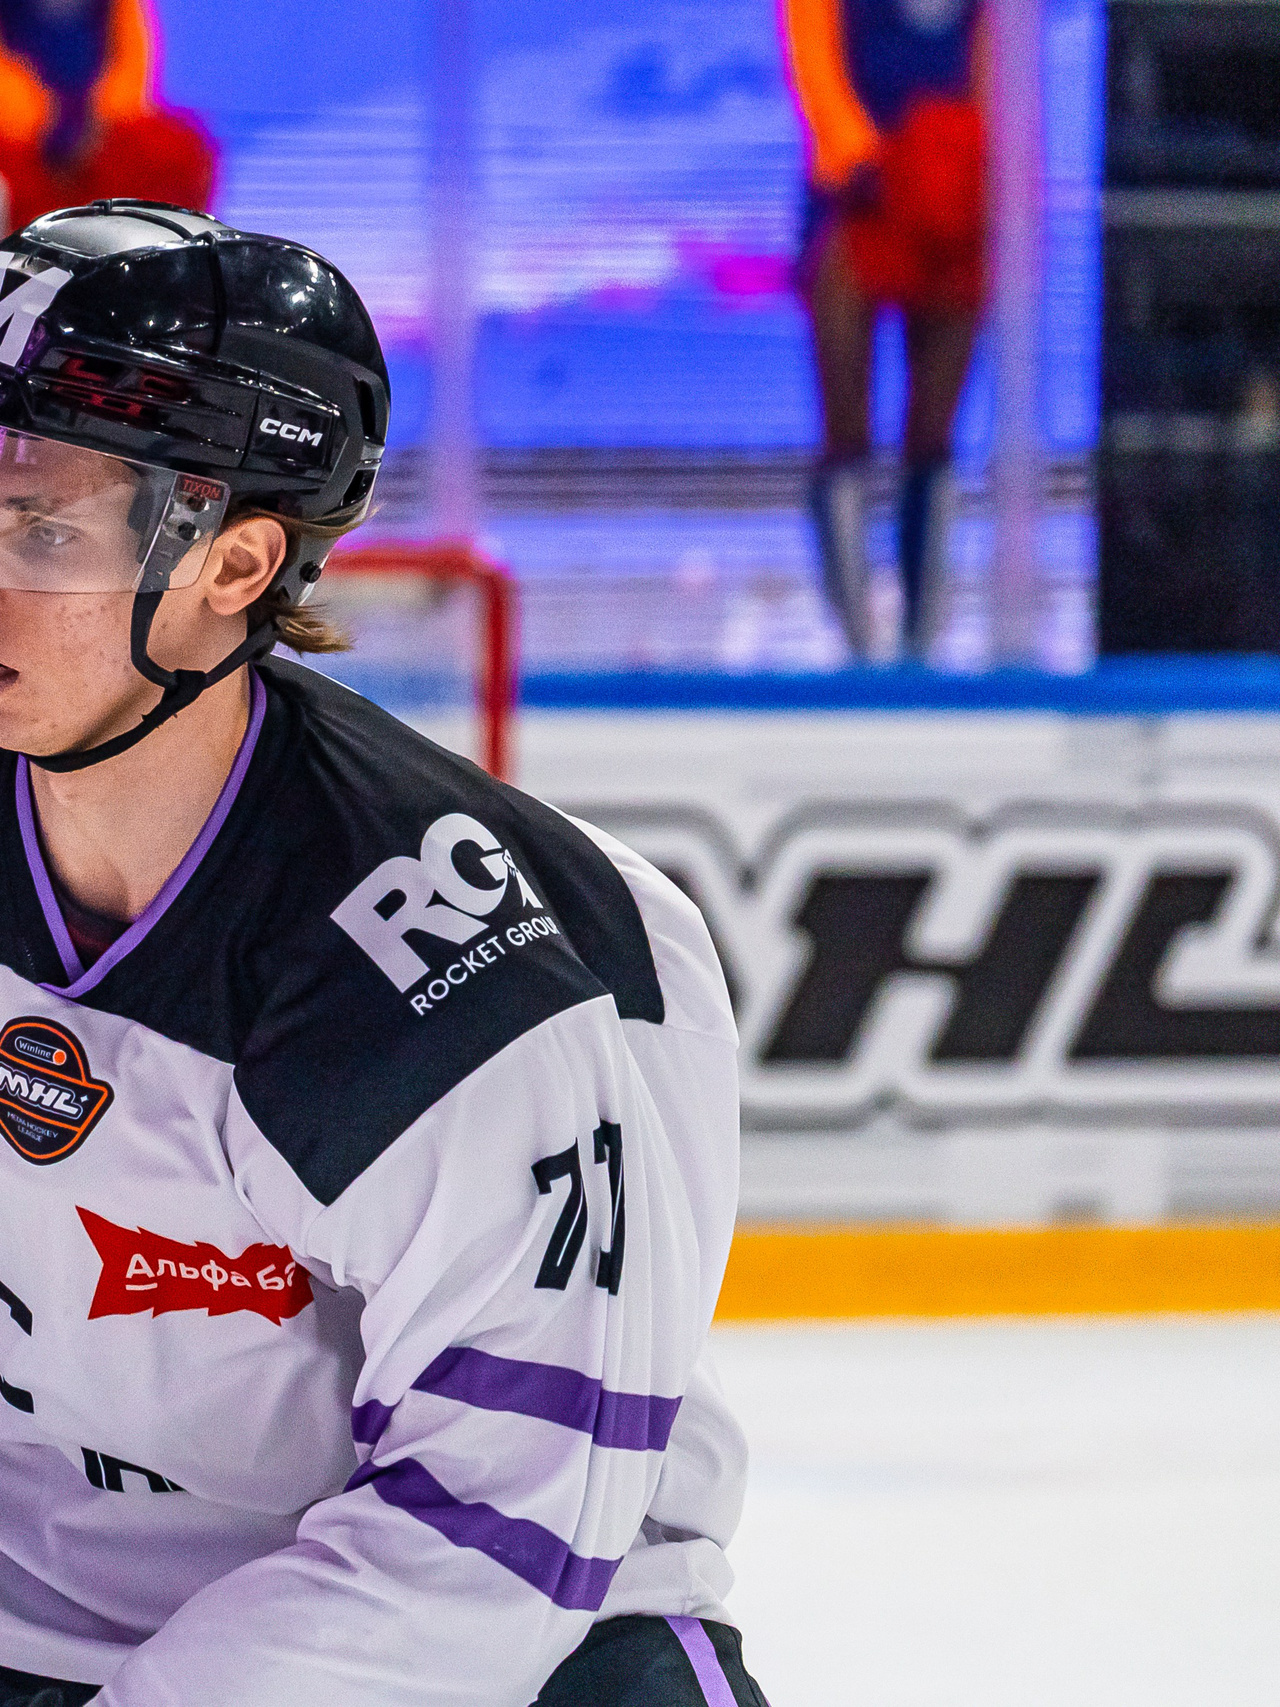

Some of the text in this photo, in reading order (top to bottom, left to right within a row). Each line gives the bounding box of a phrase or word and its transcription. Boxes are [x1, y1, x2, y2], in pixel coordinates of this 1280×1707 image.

[259, 417, 323, 447] CCM
[409, 936, 506, 1017] ROCKET
[18, 1039, 52, 1060] Winline
[125, 1253, 252, 1291] Альфа
